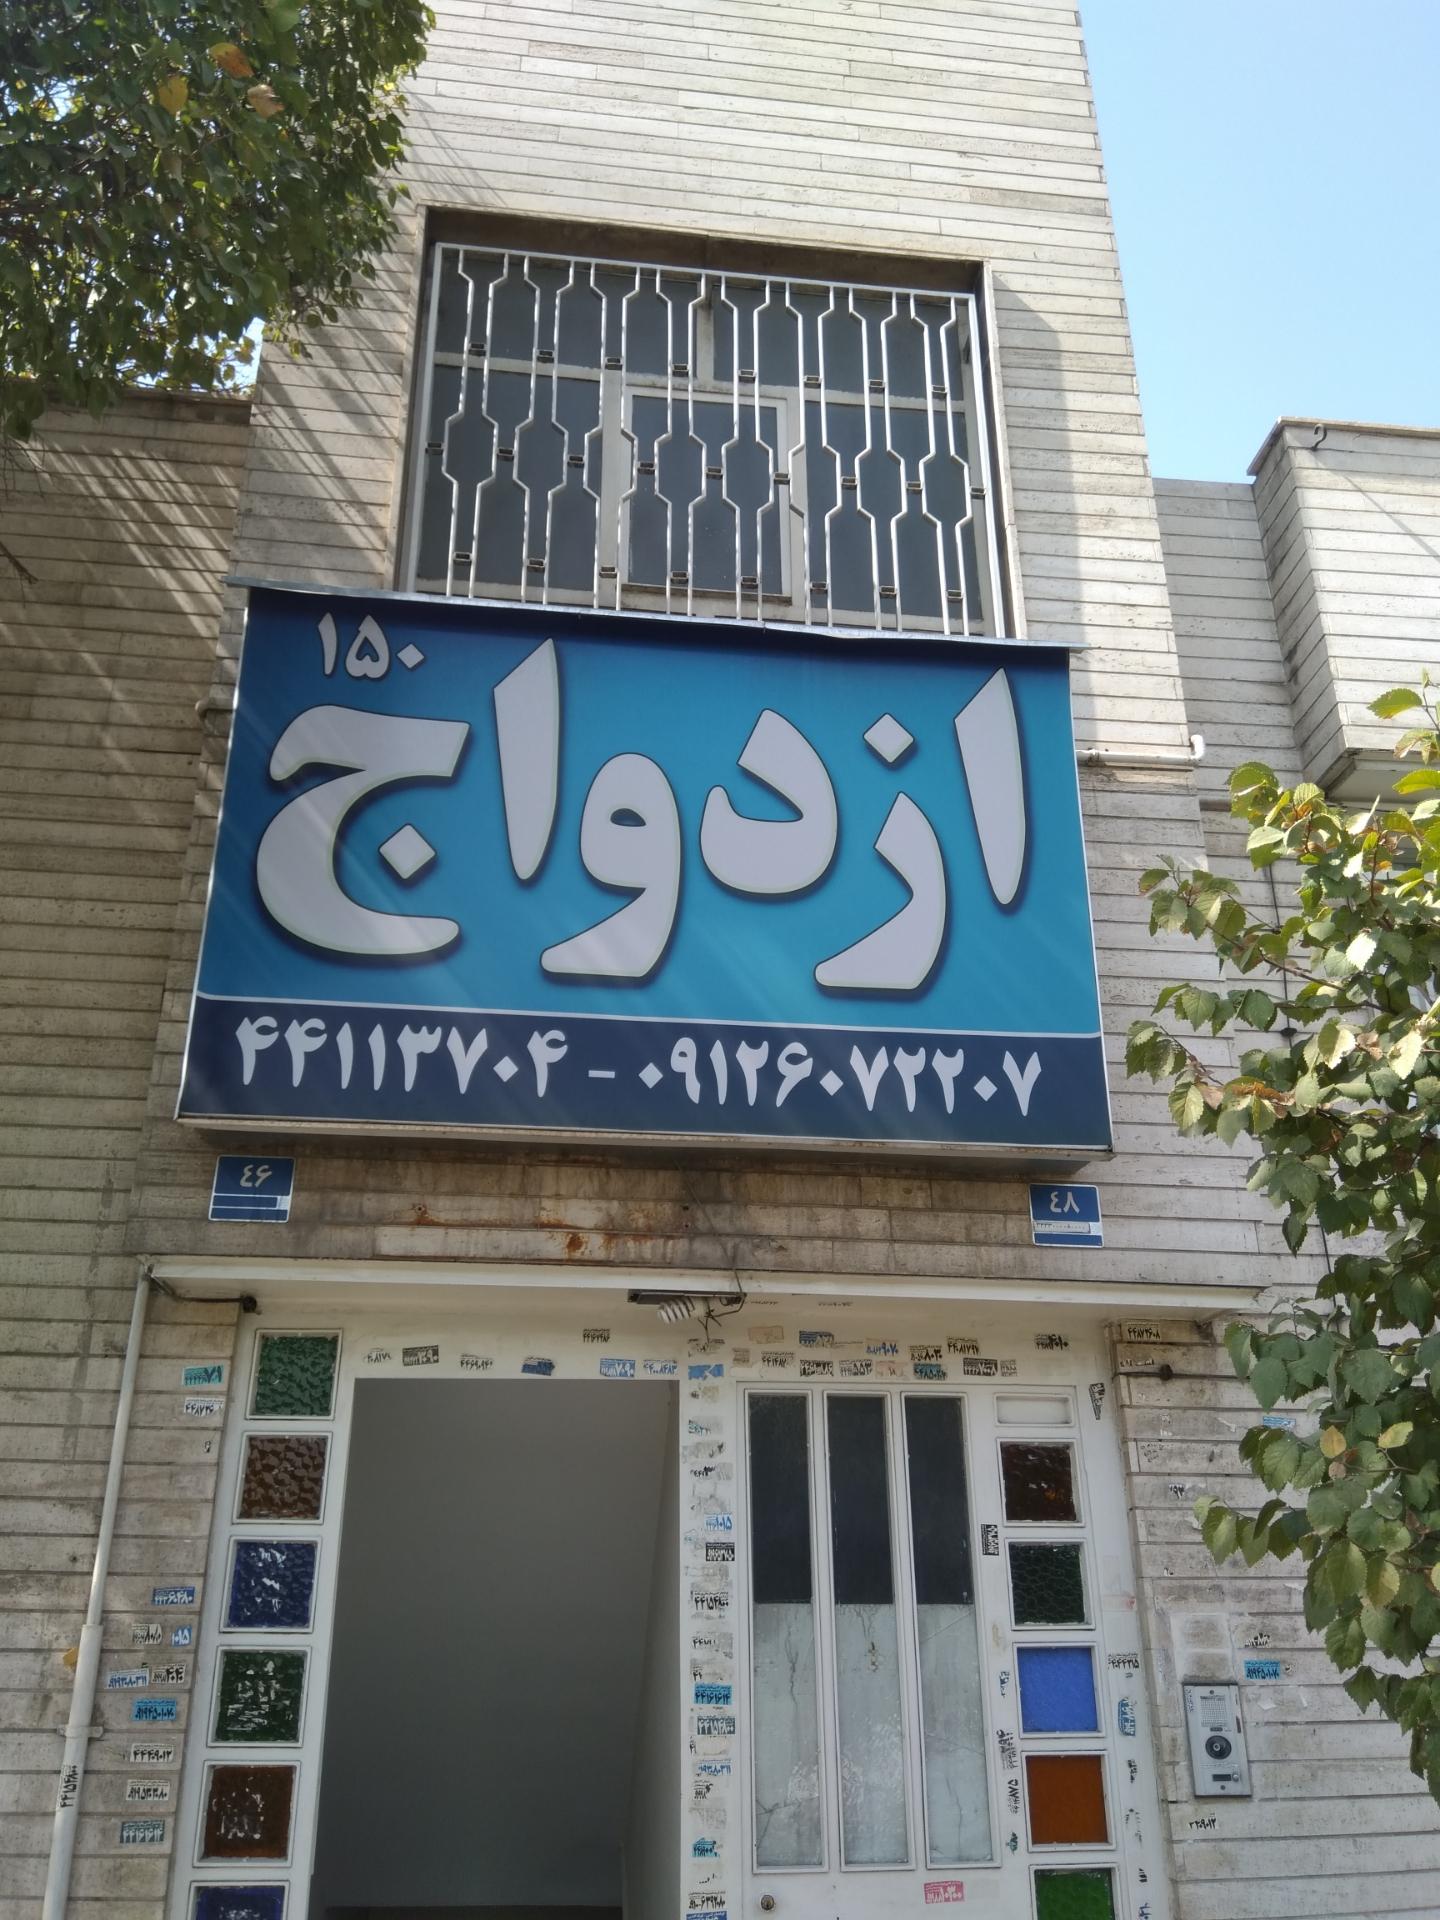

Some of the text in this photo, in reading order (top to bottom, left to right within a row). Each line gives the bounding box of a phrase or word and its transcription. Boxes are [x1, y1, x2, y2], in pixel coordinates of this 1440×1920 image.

[318, 612, 424, 680] ۱۵۰
[256, 638, 1026, 990] ازدواج
[237, 1015, 569, 1099] ۴۴۱۱۳۷۰۴
[640, 1036, 1043, 1117] ۰۹۱۲۶۰۷۲۲۰۷
